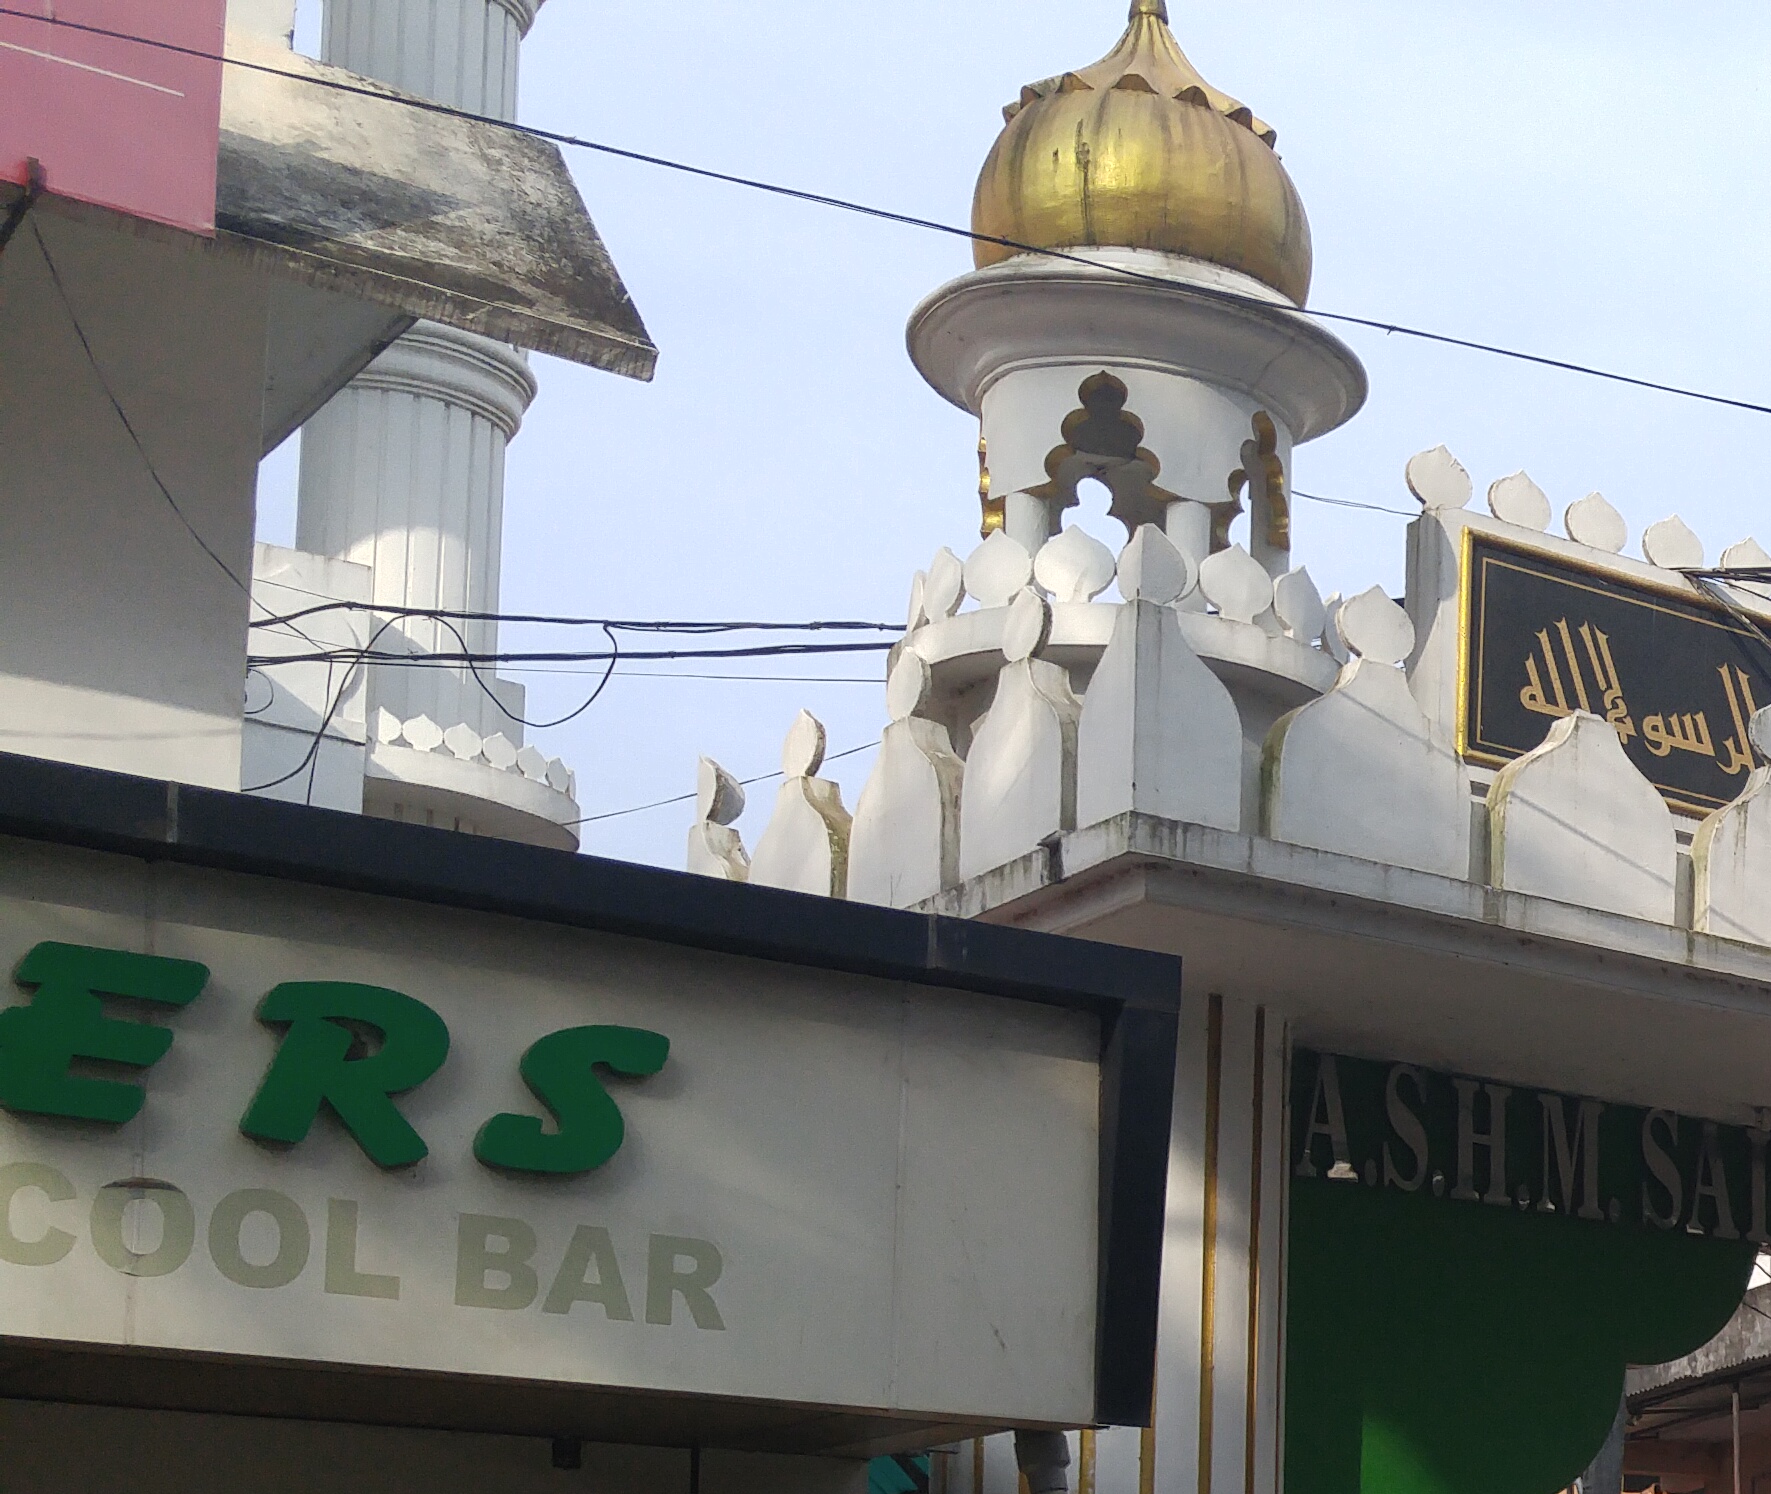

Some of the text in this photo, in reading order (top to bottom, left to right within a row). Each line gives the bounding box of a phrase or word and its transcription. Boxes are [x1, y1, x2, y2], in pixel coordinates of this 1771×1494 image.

[1294, 1053, 1622, 1225] A.S.H.M.
[0, 1161, 728, 1332] COOL BAR
